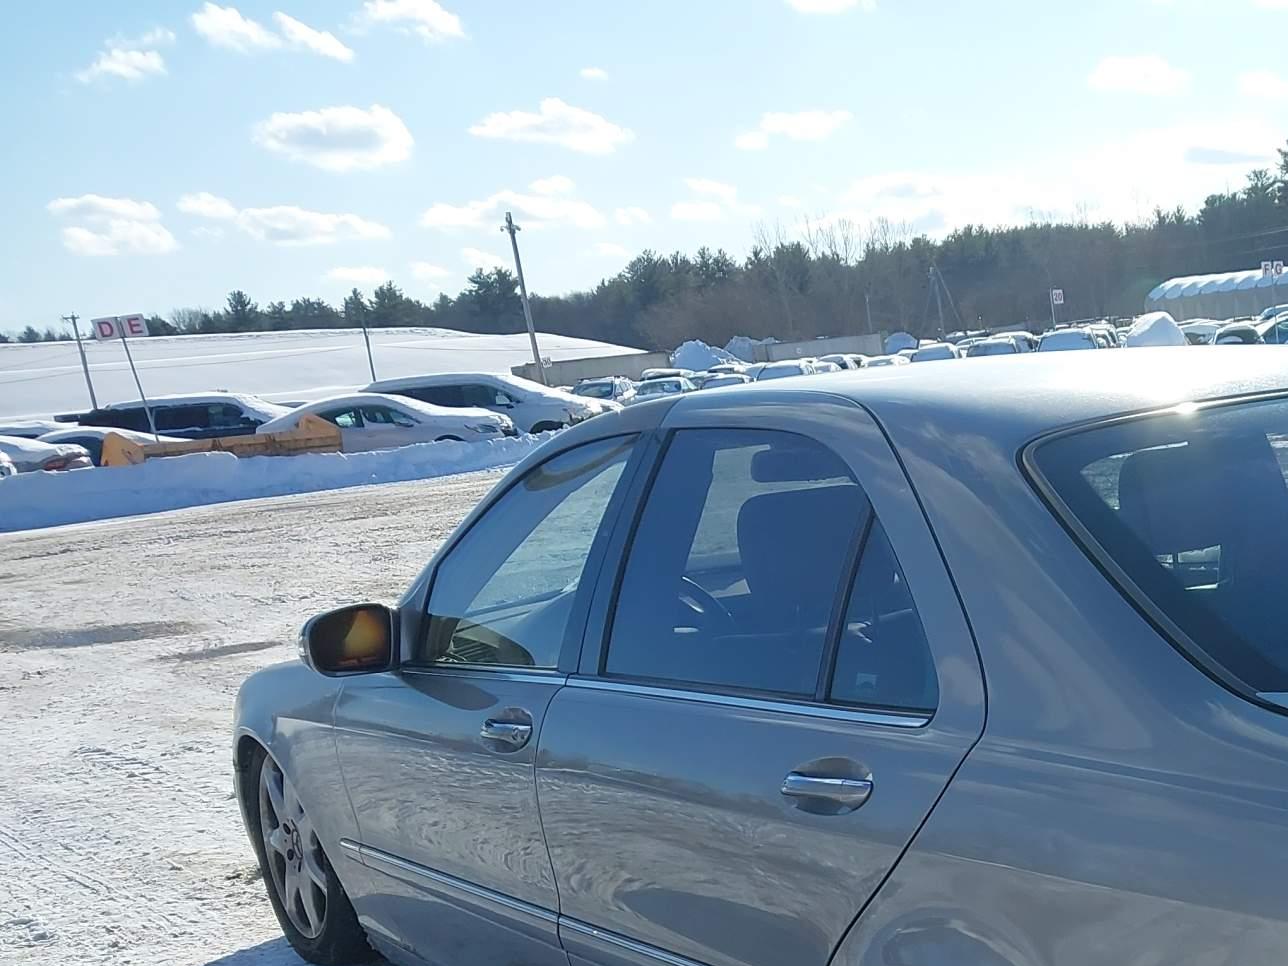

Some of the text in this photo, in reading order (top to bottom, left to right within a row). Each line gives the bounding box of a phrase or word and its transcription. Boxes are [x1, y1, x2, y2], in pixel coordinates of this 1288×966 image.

[1264, 263, 1271, 276] F
[1275, 263, 1283, 276] G
[97, 321, 115, 338] D
[127, 317, 144, 334] E
